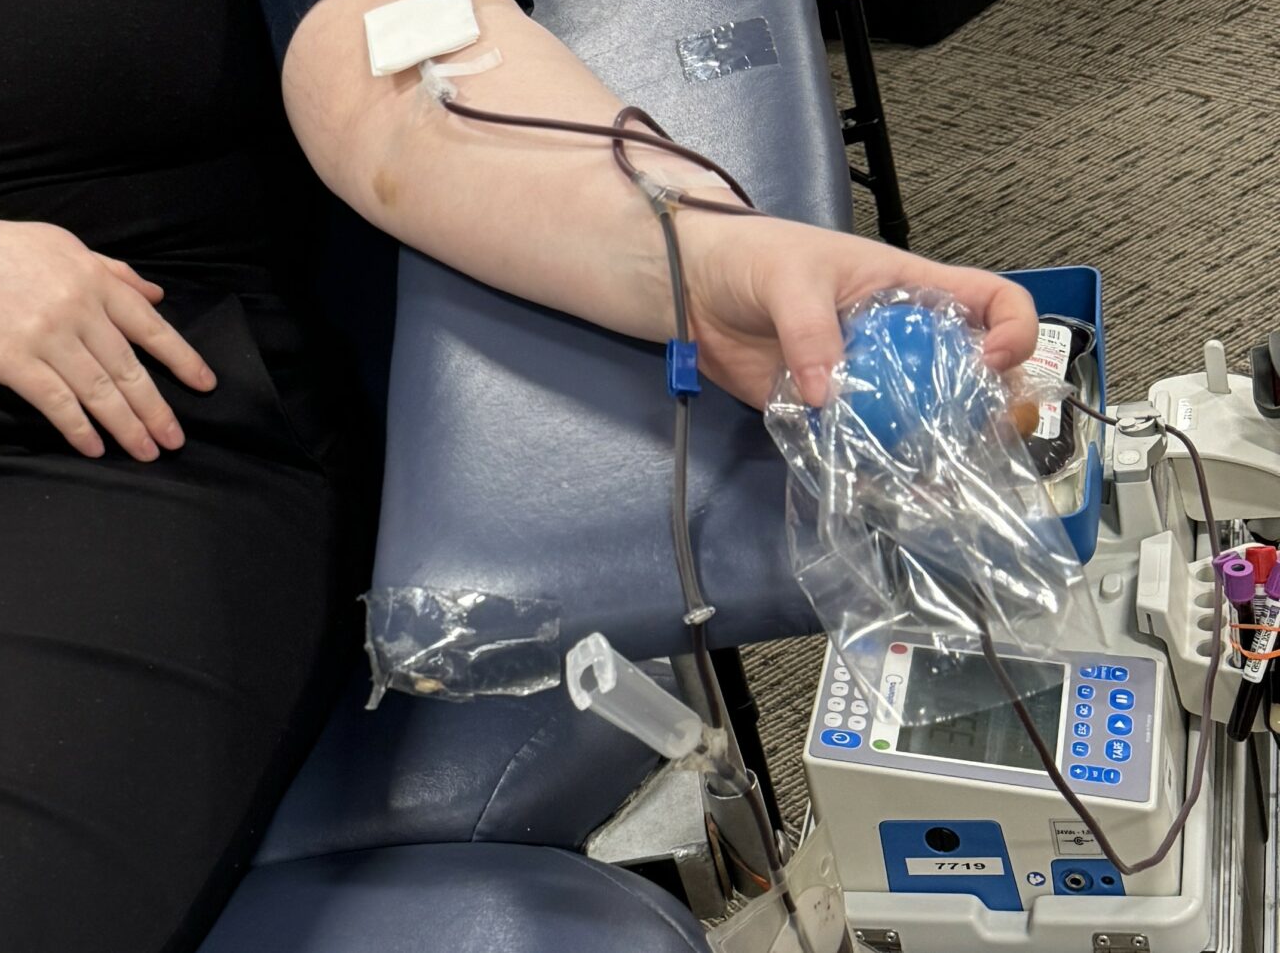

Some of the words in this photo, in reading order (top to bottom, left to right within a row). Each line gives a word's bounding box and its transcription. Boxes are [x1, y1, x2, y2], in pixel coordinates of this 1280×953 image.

[1078, 724, 1087, 736] ESC
[1112, 741, 1124, 759] TARE
[934, 862, 986, 870] 7719
